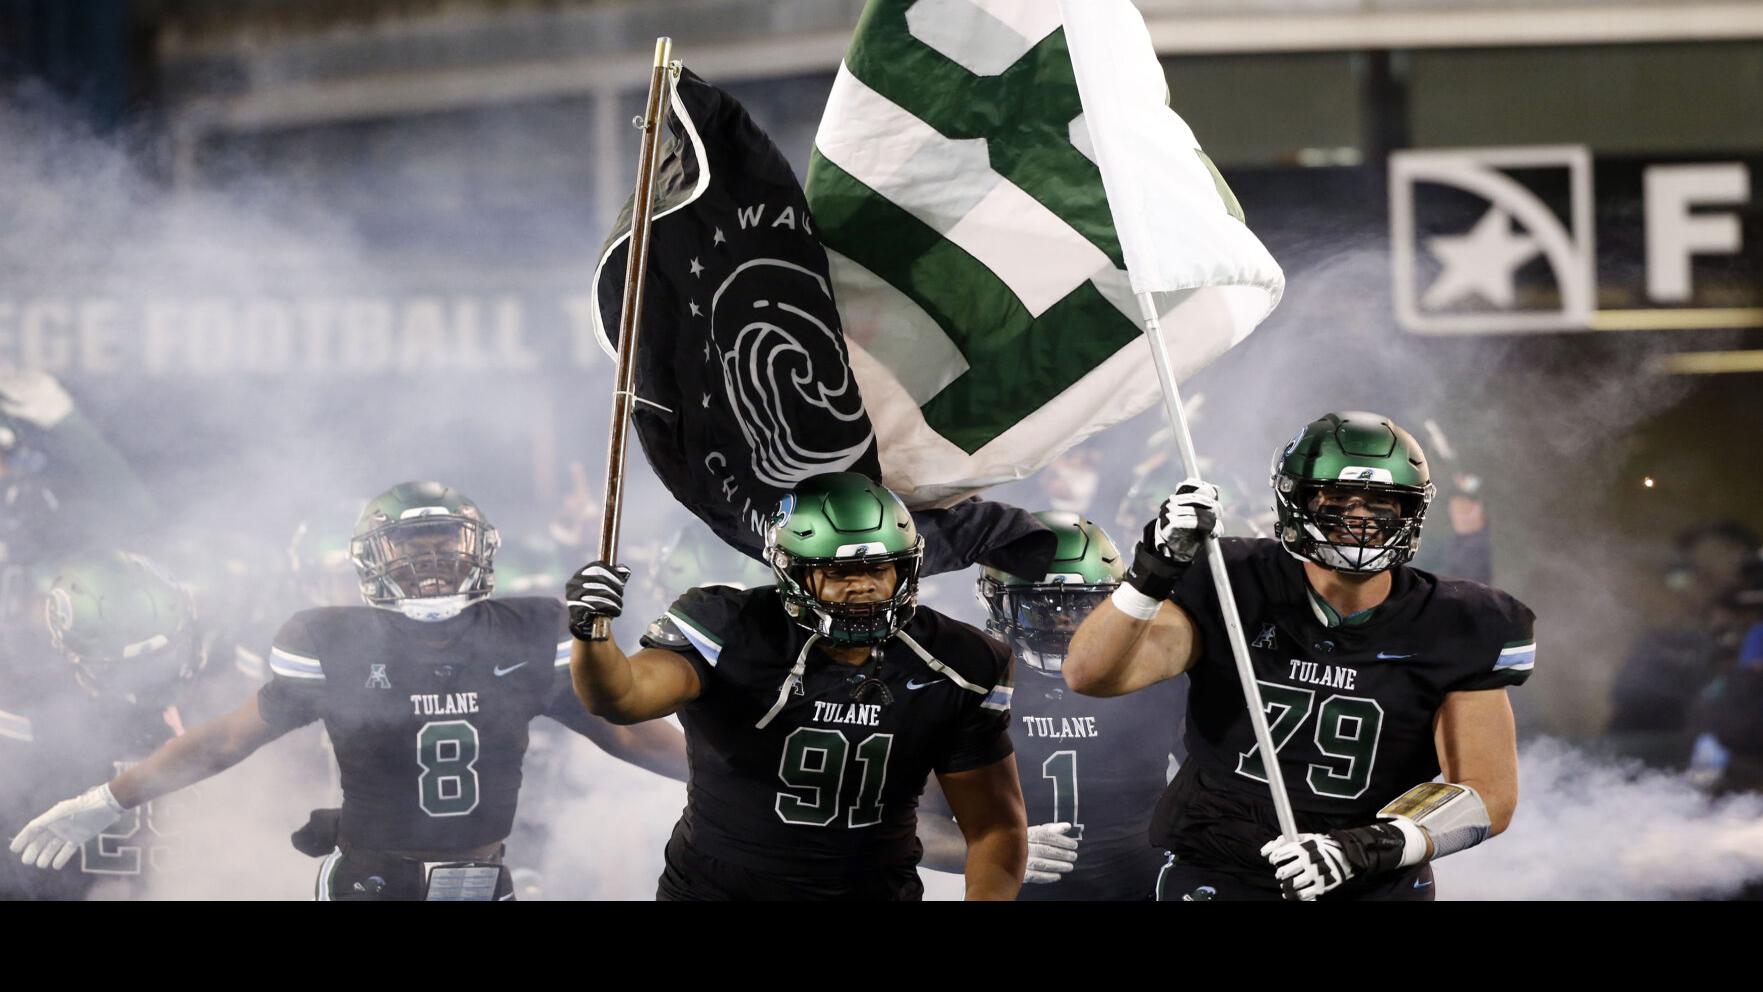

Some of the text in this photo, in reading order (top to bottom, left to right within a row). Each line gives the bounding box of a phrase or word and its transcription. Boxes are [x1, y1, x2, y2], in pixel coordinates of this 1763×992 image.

[1643, 162, 1752, 304] F
[0, 299, 121, 370] GE
[142, 292, 539, 370] FOOTBALL
[410, 692, 479, 715] TULANE
[813, 701, 882, 727] TULANE
[1289, 659, 1357, 690] TULANE
[416, 719, 480, 817] 8
[1022, 715, 1098, 738] TULANE
[1235, 680, 1385, 799] 79
[774, 726, 894, 829] 91
[1042, 750, 1085, 841] 1
